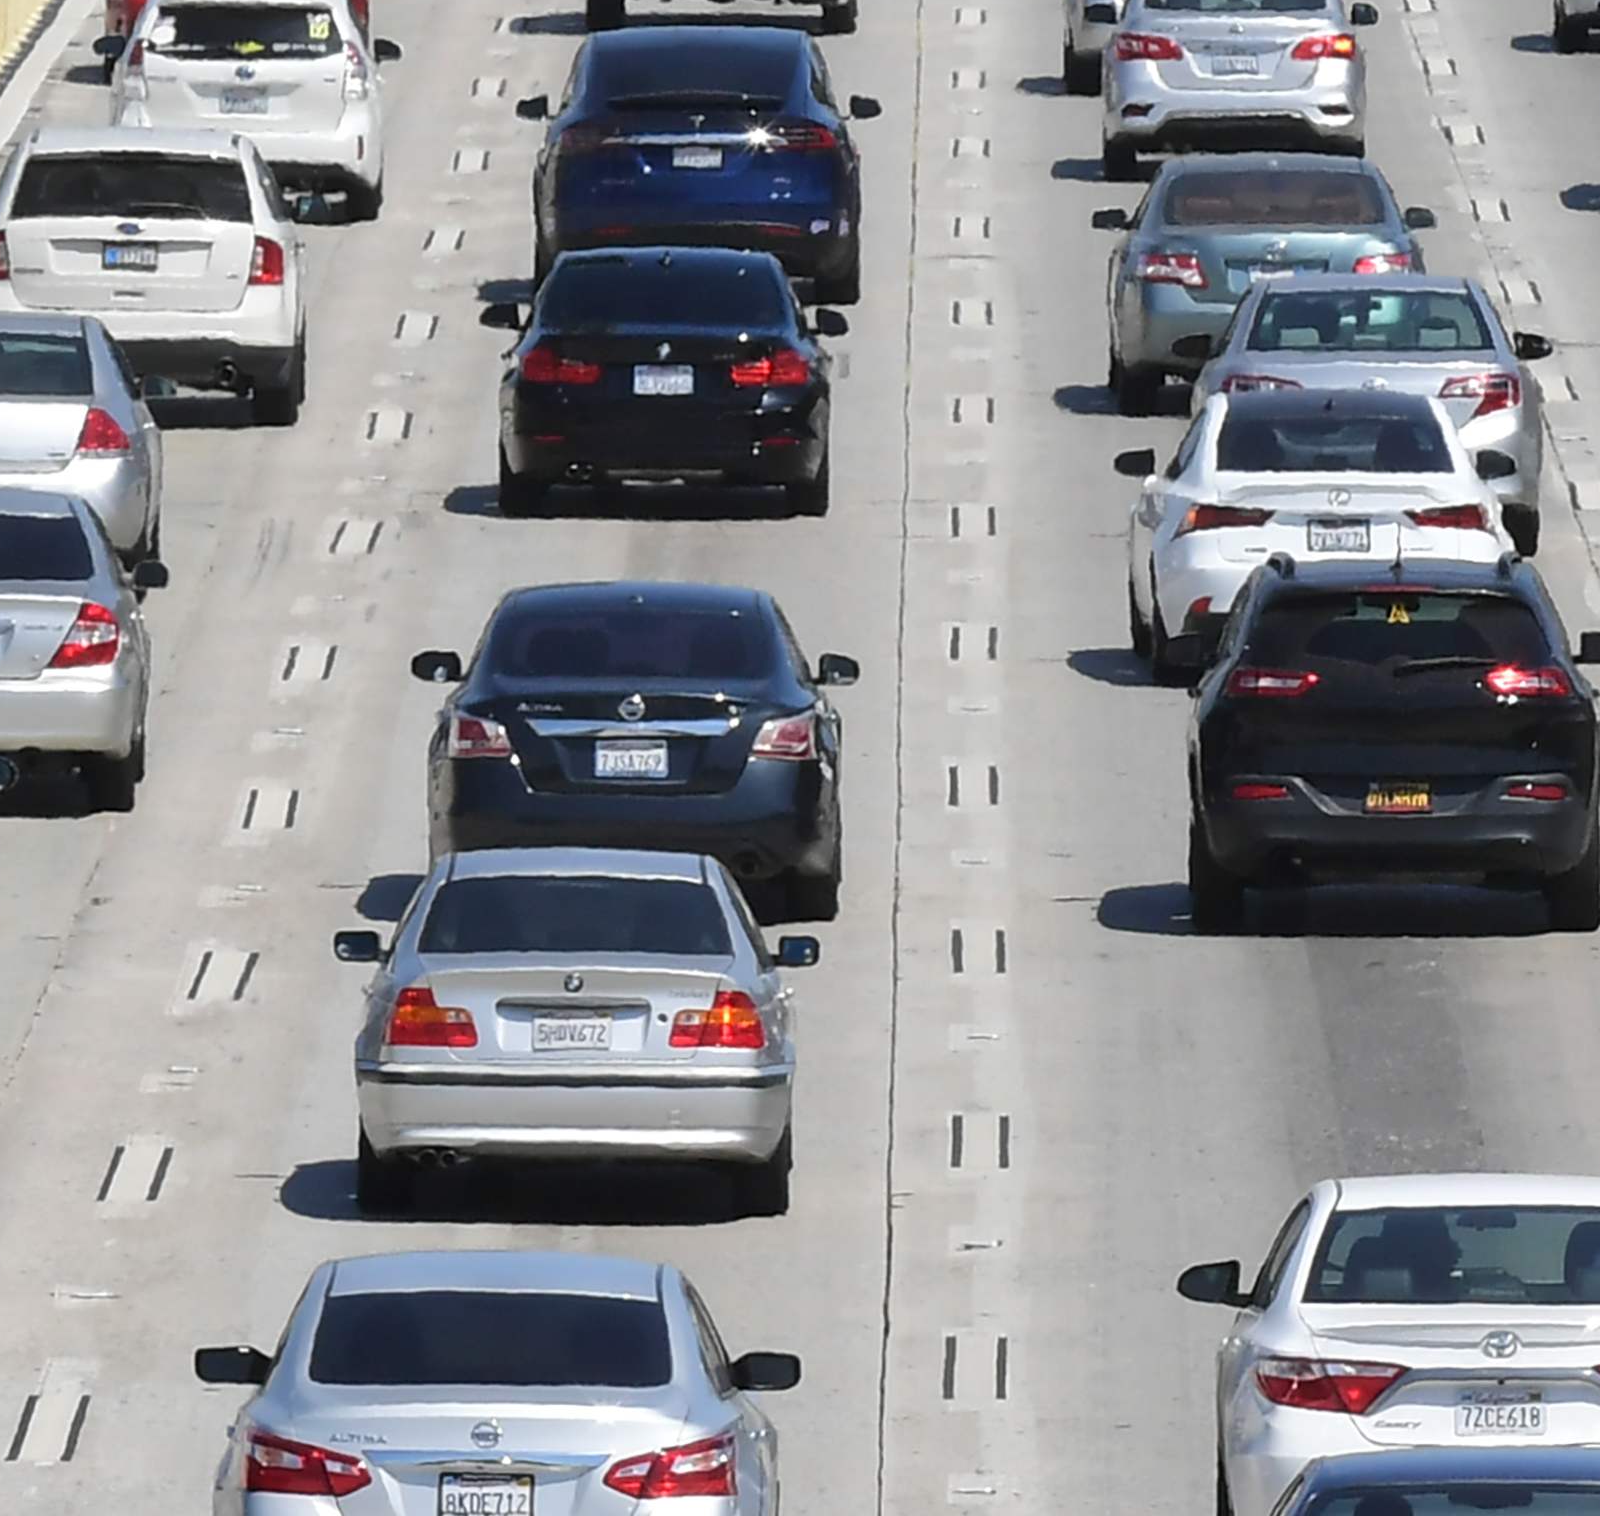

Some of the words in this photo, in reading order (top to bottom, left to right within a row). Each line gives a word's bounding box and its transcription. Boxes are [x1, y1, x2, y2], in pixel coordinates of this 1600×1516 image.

[1462, 1405, 1541, 1429] 7ZCE618
[329, 1432, 388, 1445] ALTIMA
[445, 1492, 528, 1515] 8KDE712
